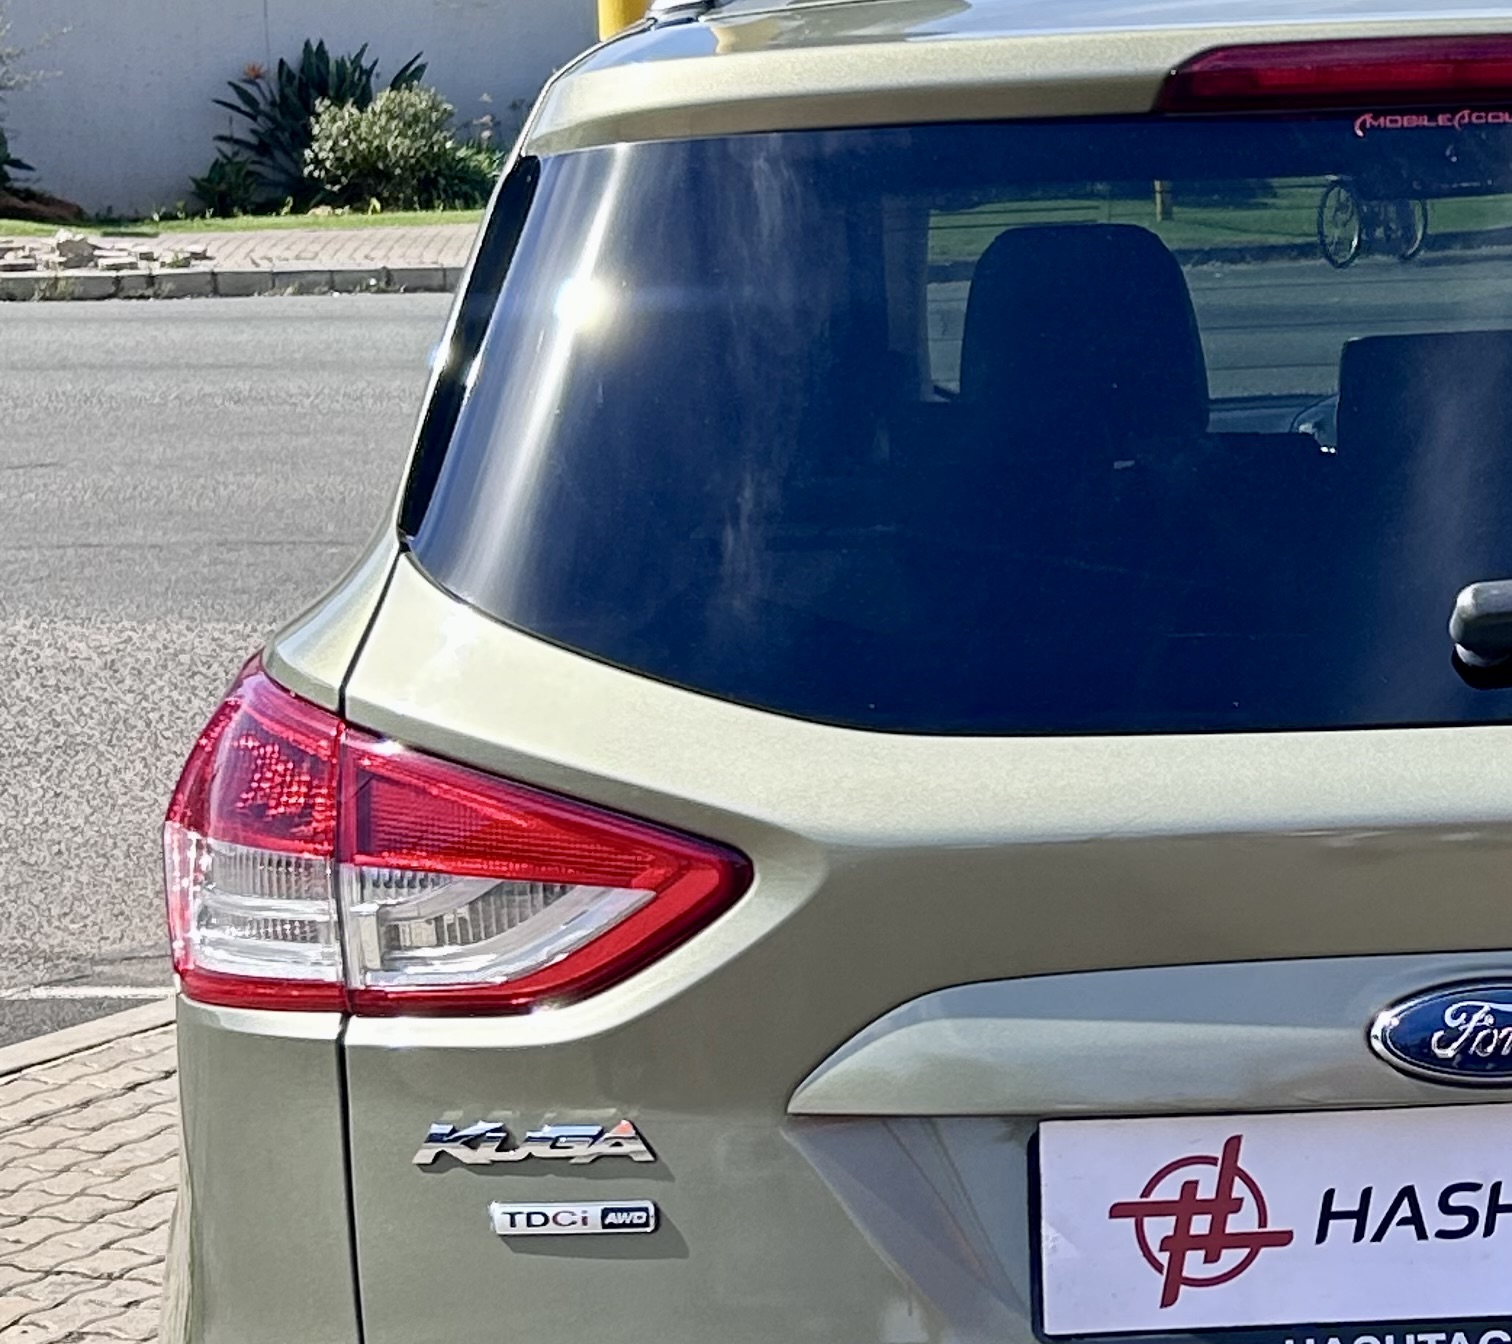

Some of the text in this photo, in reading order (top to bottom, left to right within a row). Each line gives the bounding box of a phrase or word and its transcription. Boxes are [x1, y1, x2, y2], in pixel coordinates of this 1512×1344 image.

[412, 1120, 656, 1166] KUGA
[502, 1208, 648, 1230] TDCi AWD
